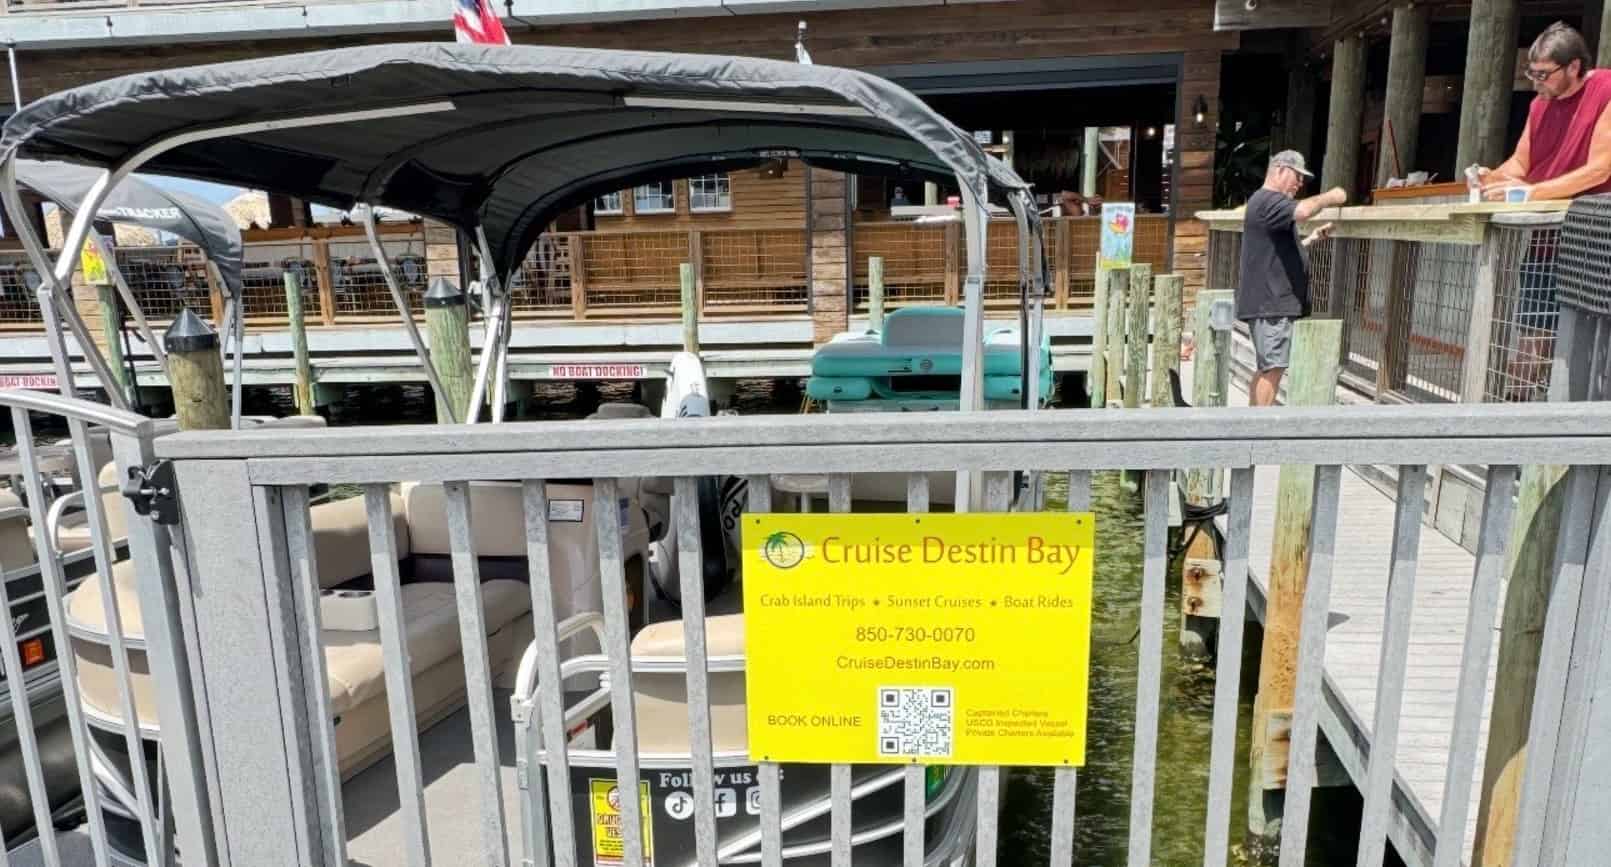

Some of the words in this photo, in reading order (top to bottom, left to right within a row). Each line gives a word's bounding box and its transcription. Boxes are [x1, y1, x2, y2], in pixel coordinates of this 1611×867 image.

[115, 206, 182, 219] TRACKER
[552, 366, 566, 377] NO
[568, 366, 593, 377] BOAT
[822, 537, 912, 564] Cruise
[922, 536, 1015, 564] Destin
[1027, 536, 1081, 575] Bay
[760, 594, 790, 608] Crab
[793, 594, 831, 608] Island
[834, 594, 866, 610] Trips
[888, 595, 930, 608] Sunset
[934, 595, 982, 608] Cruises
[1004, 595, 1034, 608] Boat
[1038, 595, 1073, 608] Rides
[855, 626, 975, 643] 850-730-0070
[836, 655, 996, 673] CruiseDestinBay.com
[767, 714, 807, 727] BOOK
[811, 715, 862, 727] ONLINE
[660, 772, 725, 787] Folw
[729, 772, 752, 784] us
